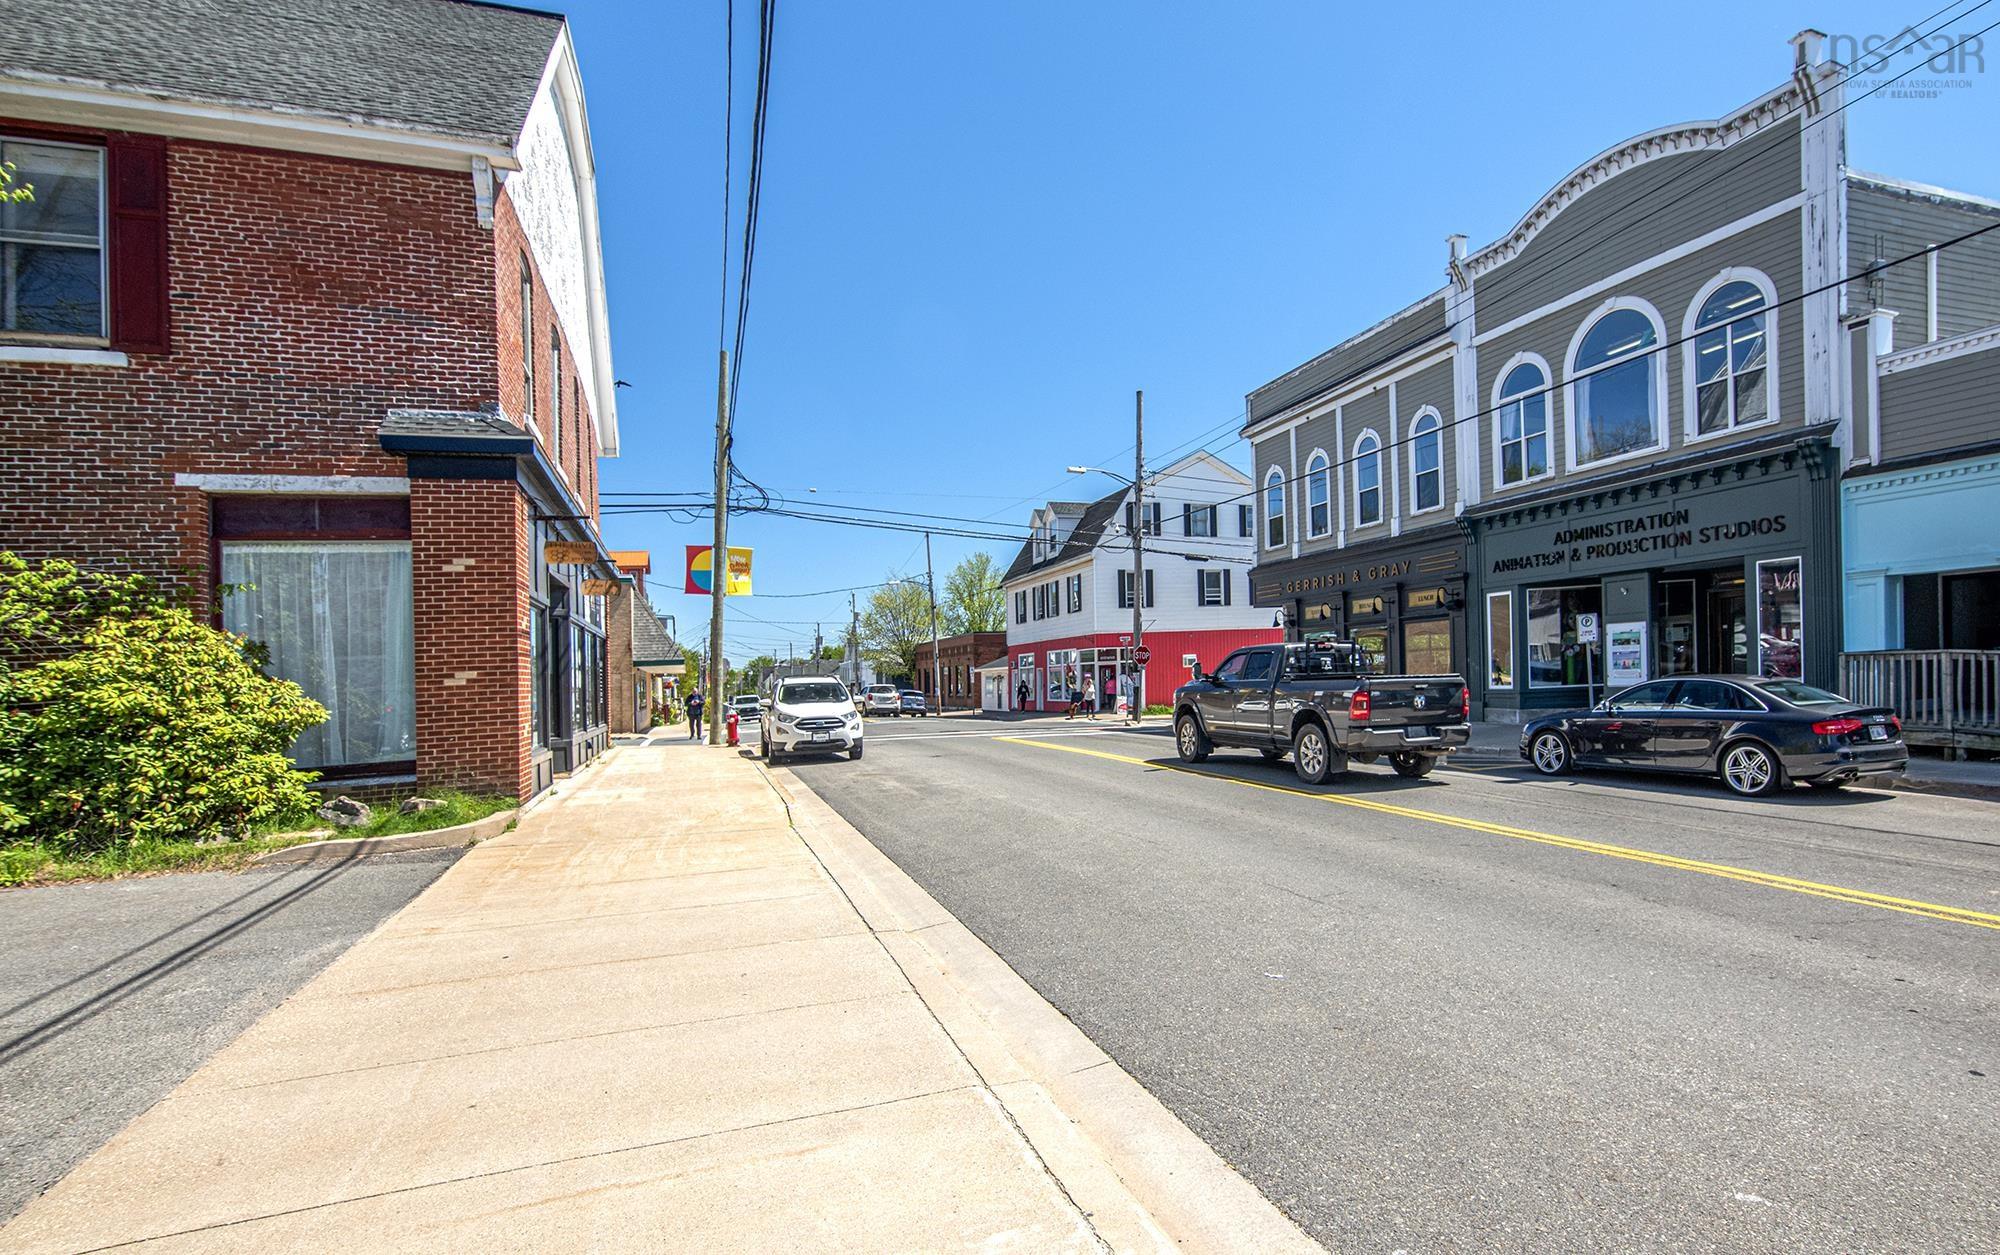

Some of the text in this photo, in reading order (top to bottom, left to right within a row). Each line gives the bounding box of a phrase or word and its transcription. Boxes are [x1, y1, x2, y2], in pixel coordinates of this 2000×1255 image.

[1492, 514, 1787, 574] ANIMATION & PRODUCTION STUDIOS
[1553, 508, 1688, 546] ADMINISTRATION
[1286, 559, 1412, 594] GERRISH & GRAY
[1135, 651, 1149, 660] STOP
